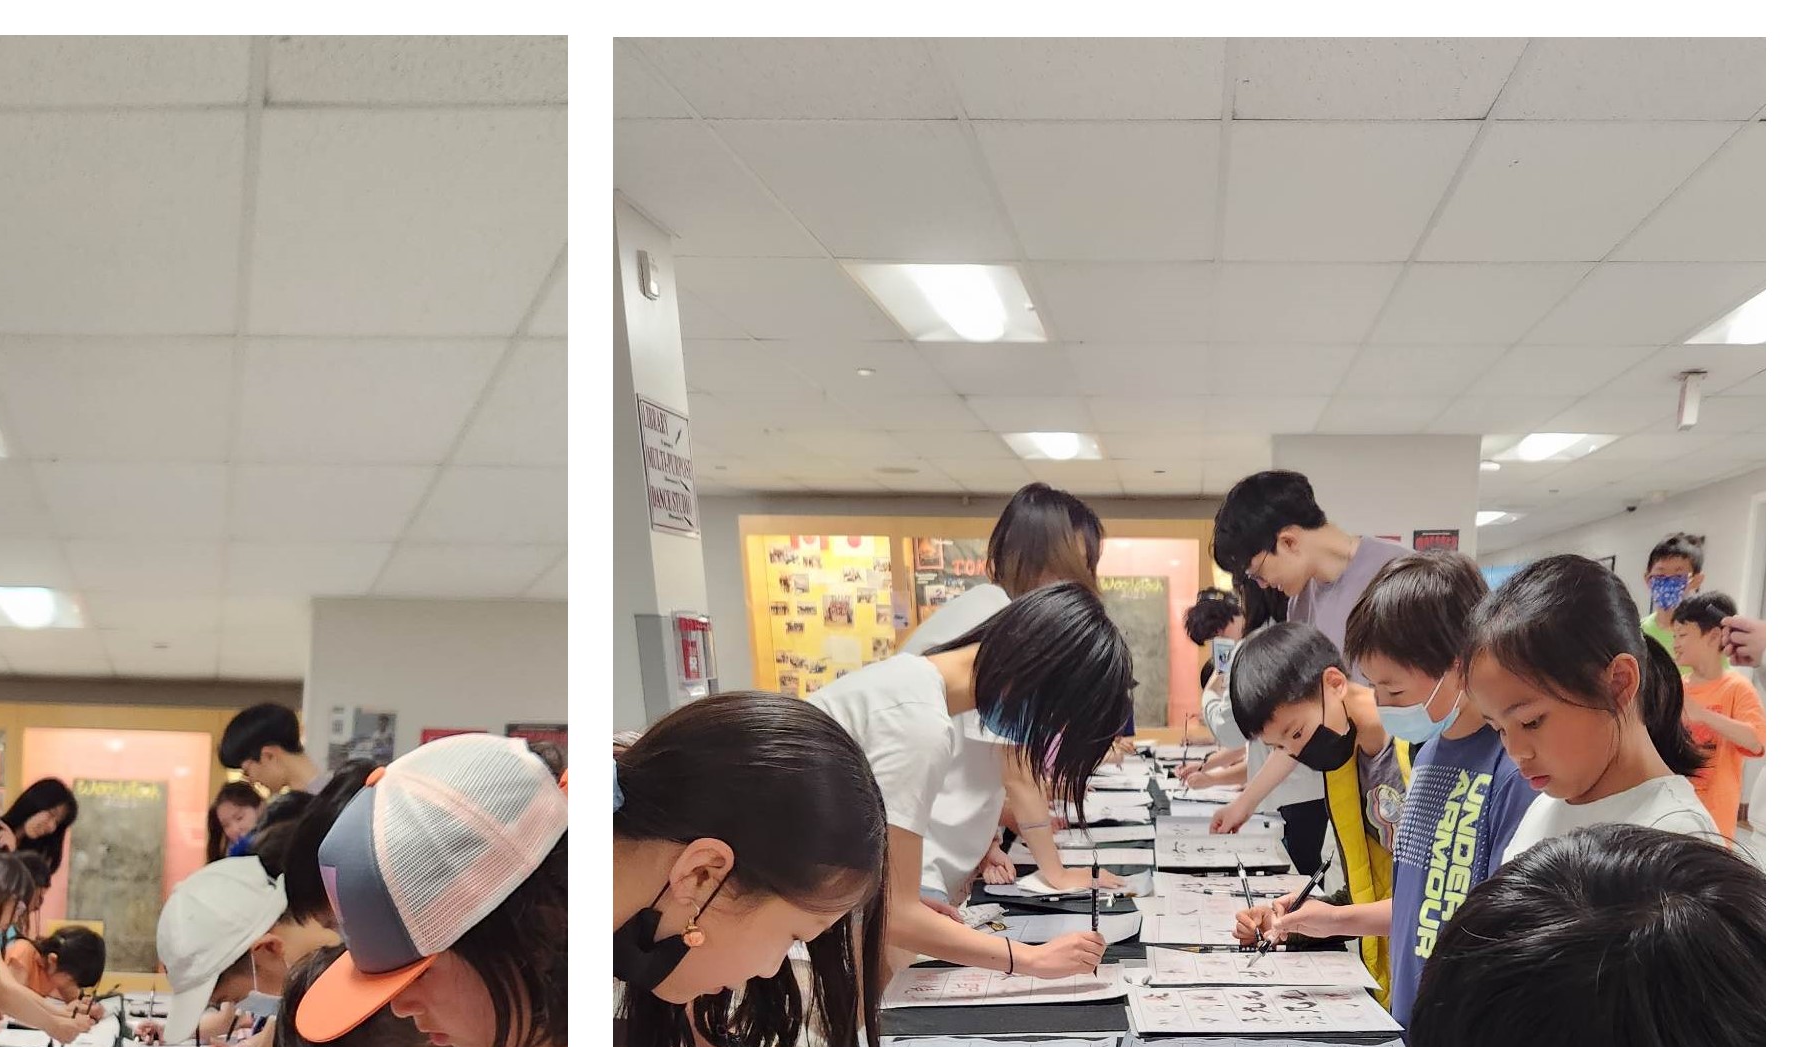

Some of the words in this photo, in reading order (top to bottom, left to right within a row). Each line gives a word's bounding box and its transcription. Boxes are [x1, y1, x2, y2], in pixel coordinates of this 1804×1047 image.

[641, 403, 668, 436] LIBRARY
[1415, 768, 1472, 960] ARMOUR
[1441, 773, 1493, 922] UNDER
